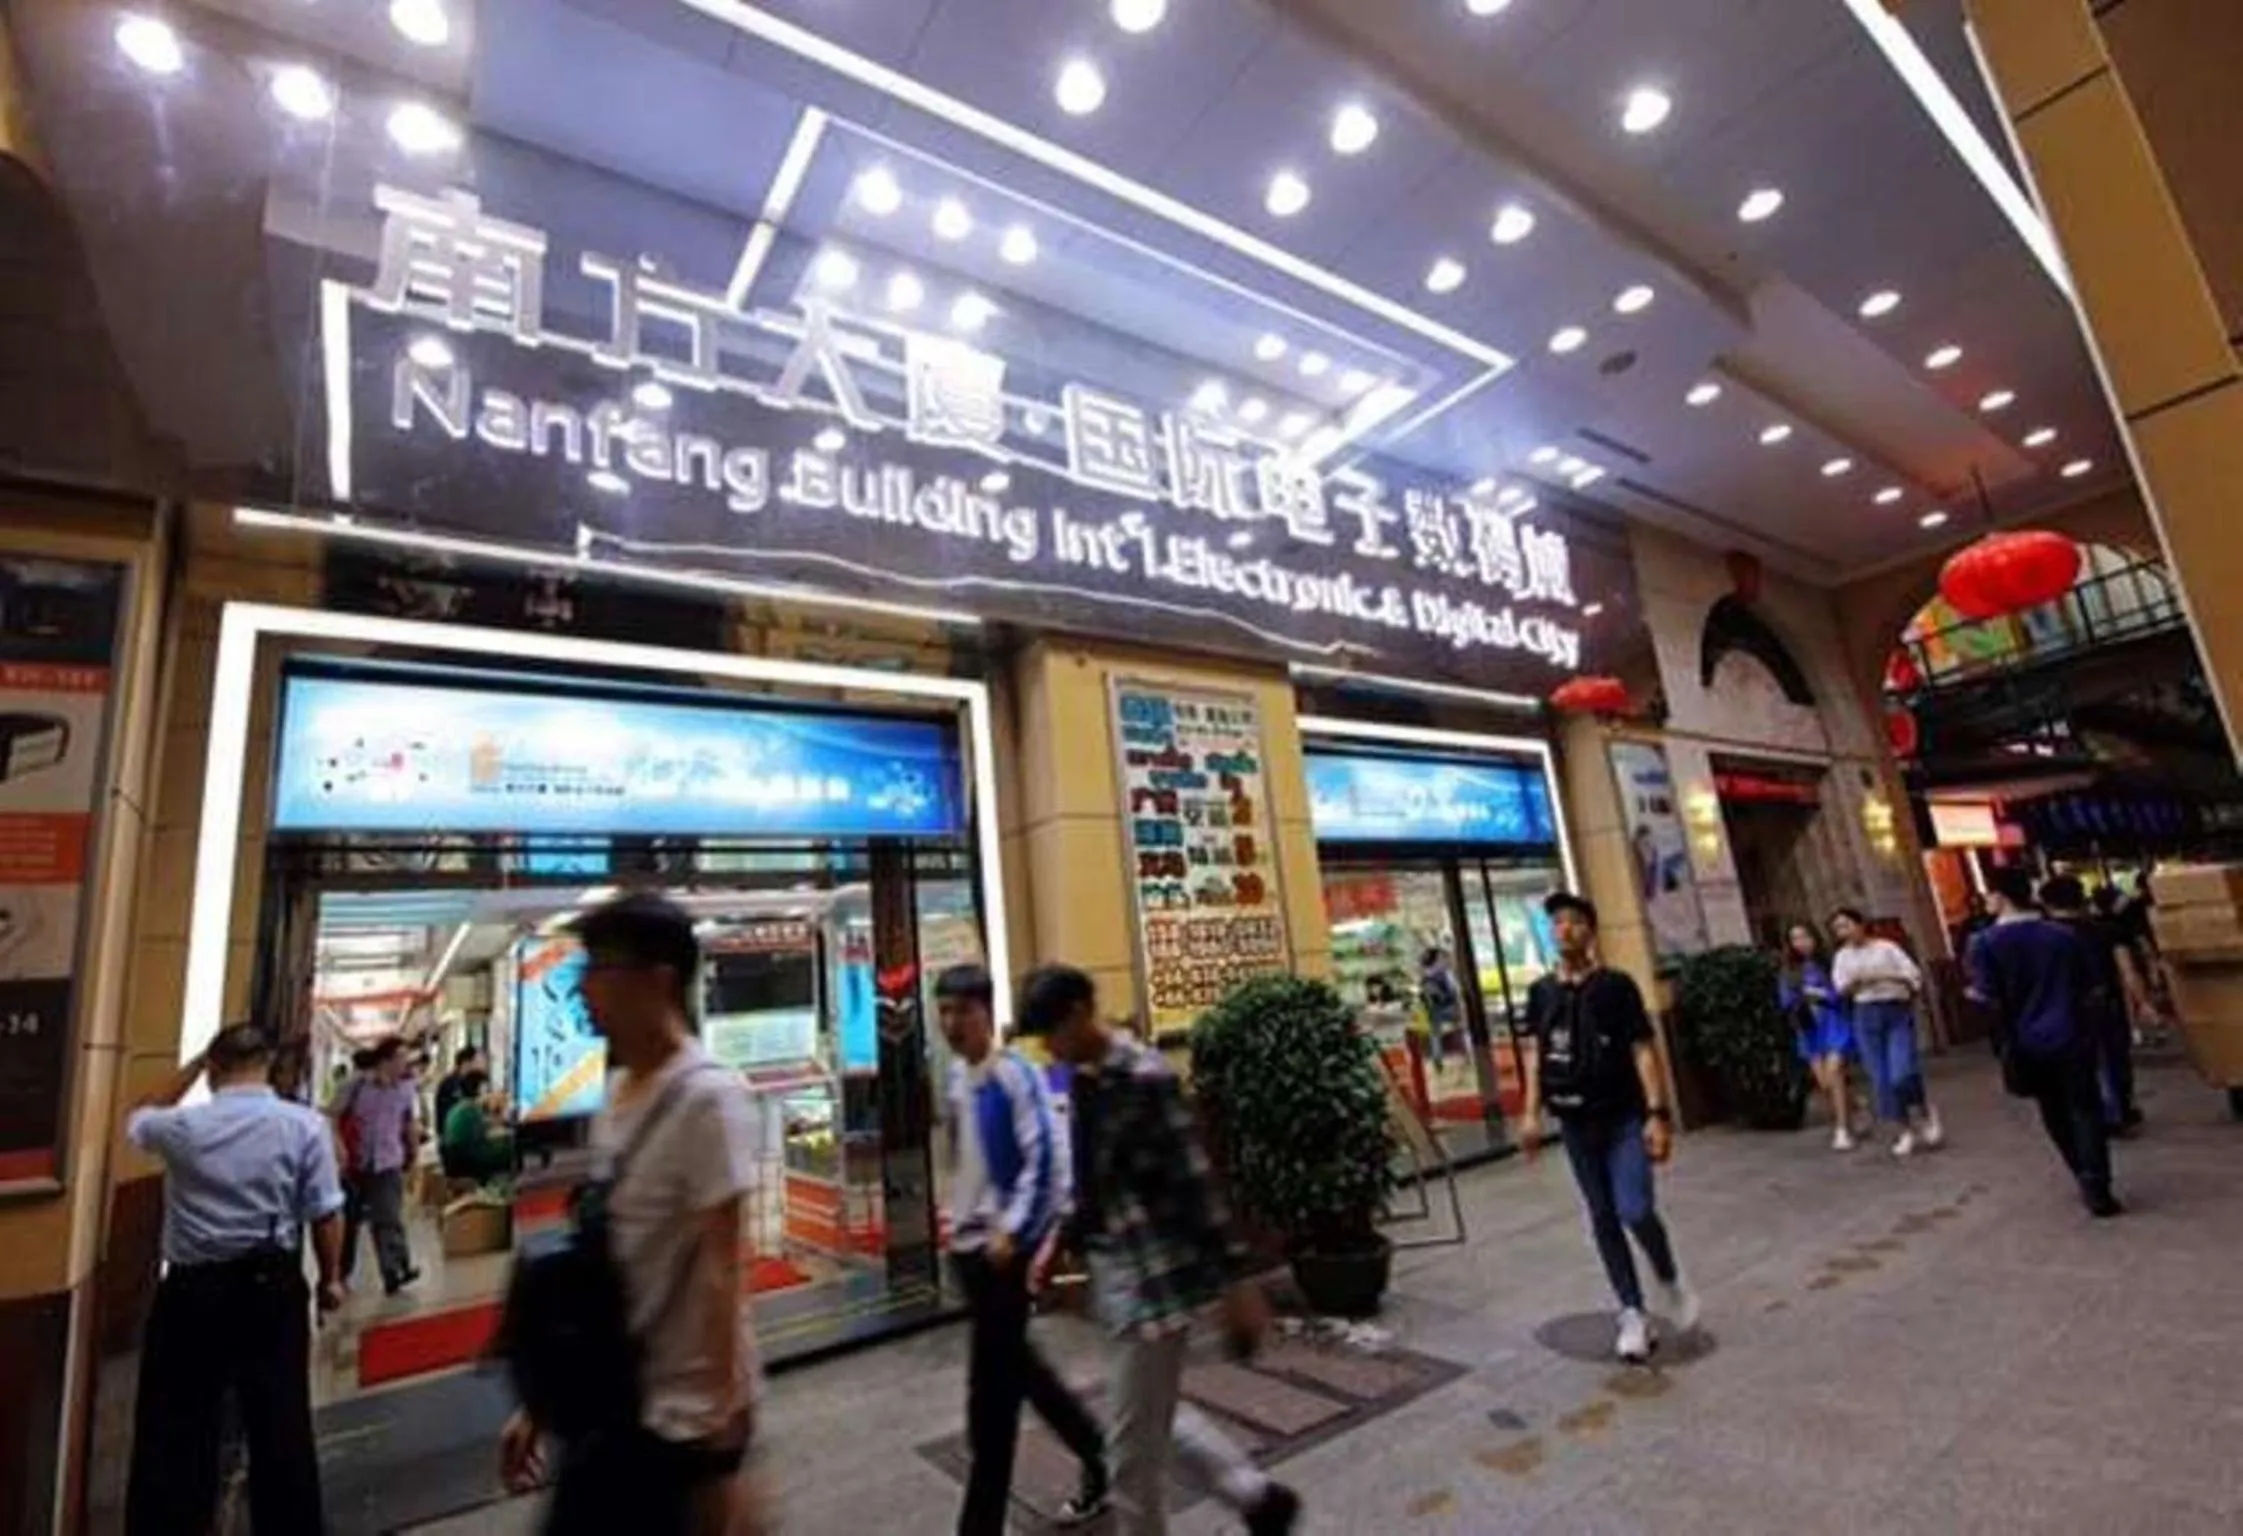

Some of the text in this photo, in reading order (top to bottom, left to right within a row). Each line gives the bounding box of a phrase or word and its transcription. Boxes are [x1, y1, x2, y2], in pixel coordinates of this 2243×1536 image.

[392, 347, 769, 513] Nanfang
[792, 450, 1038, 561] Building
[1413, 591, 1519, 649] Digital
[1520, 616, 1580, 670] City
